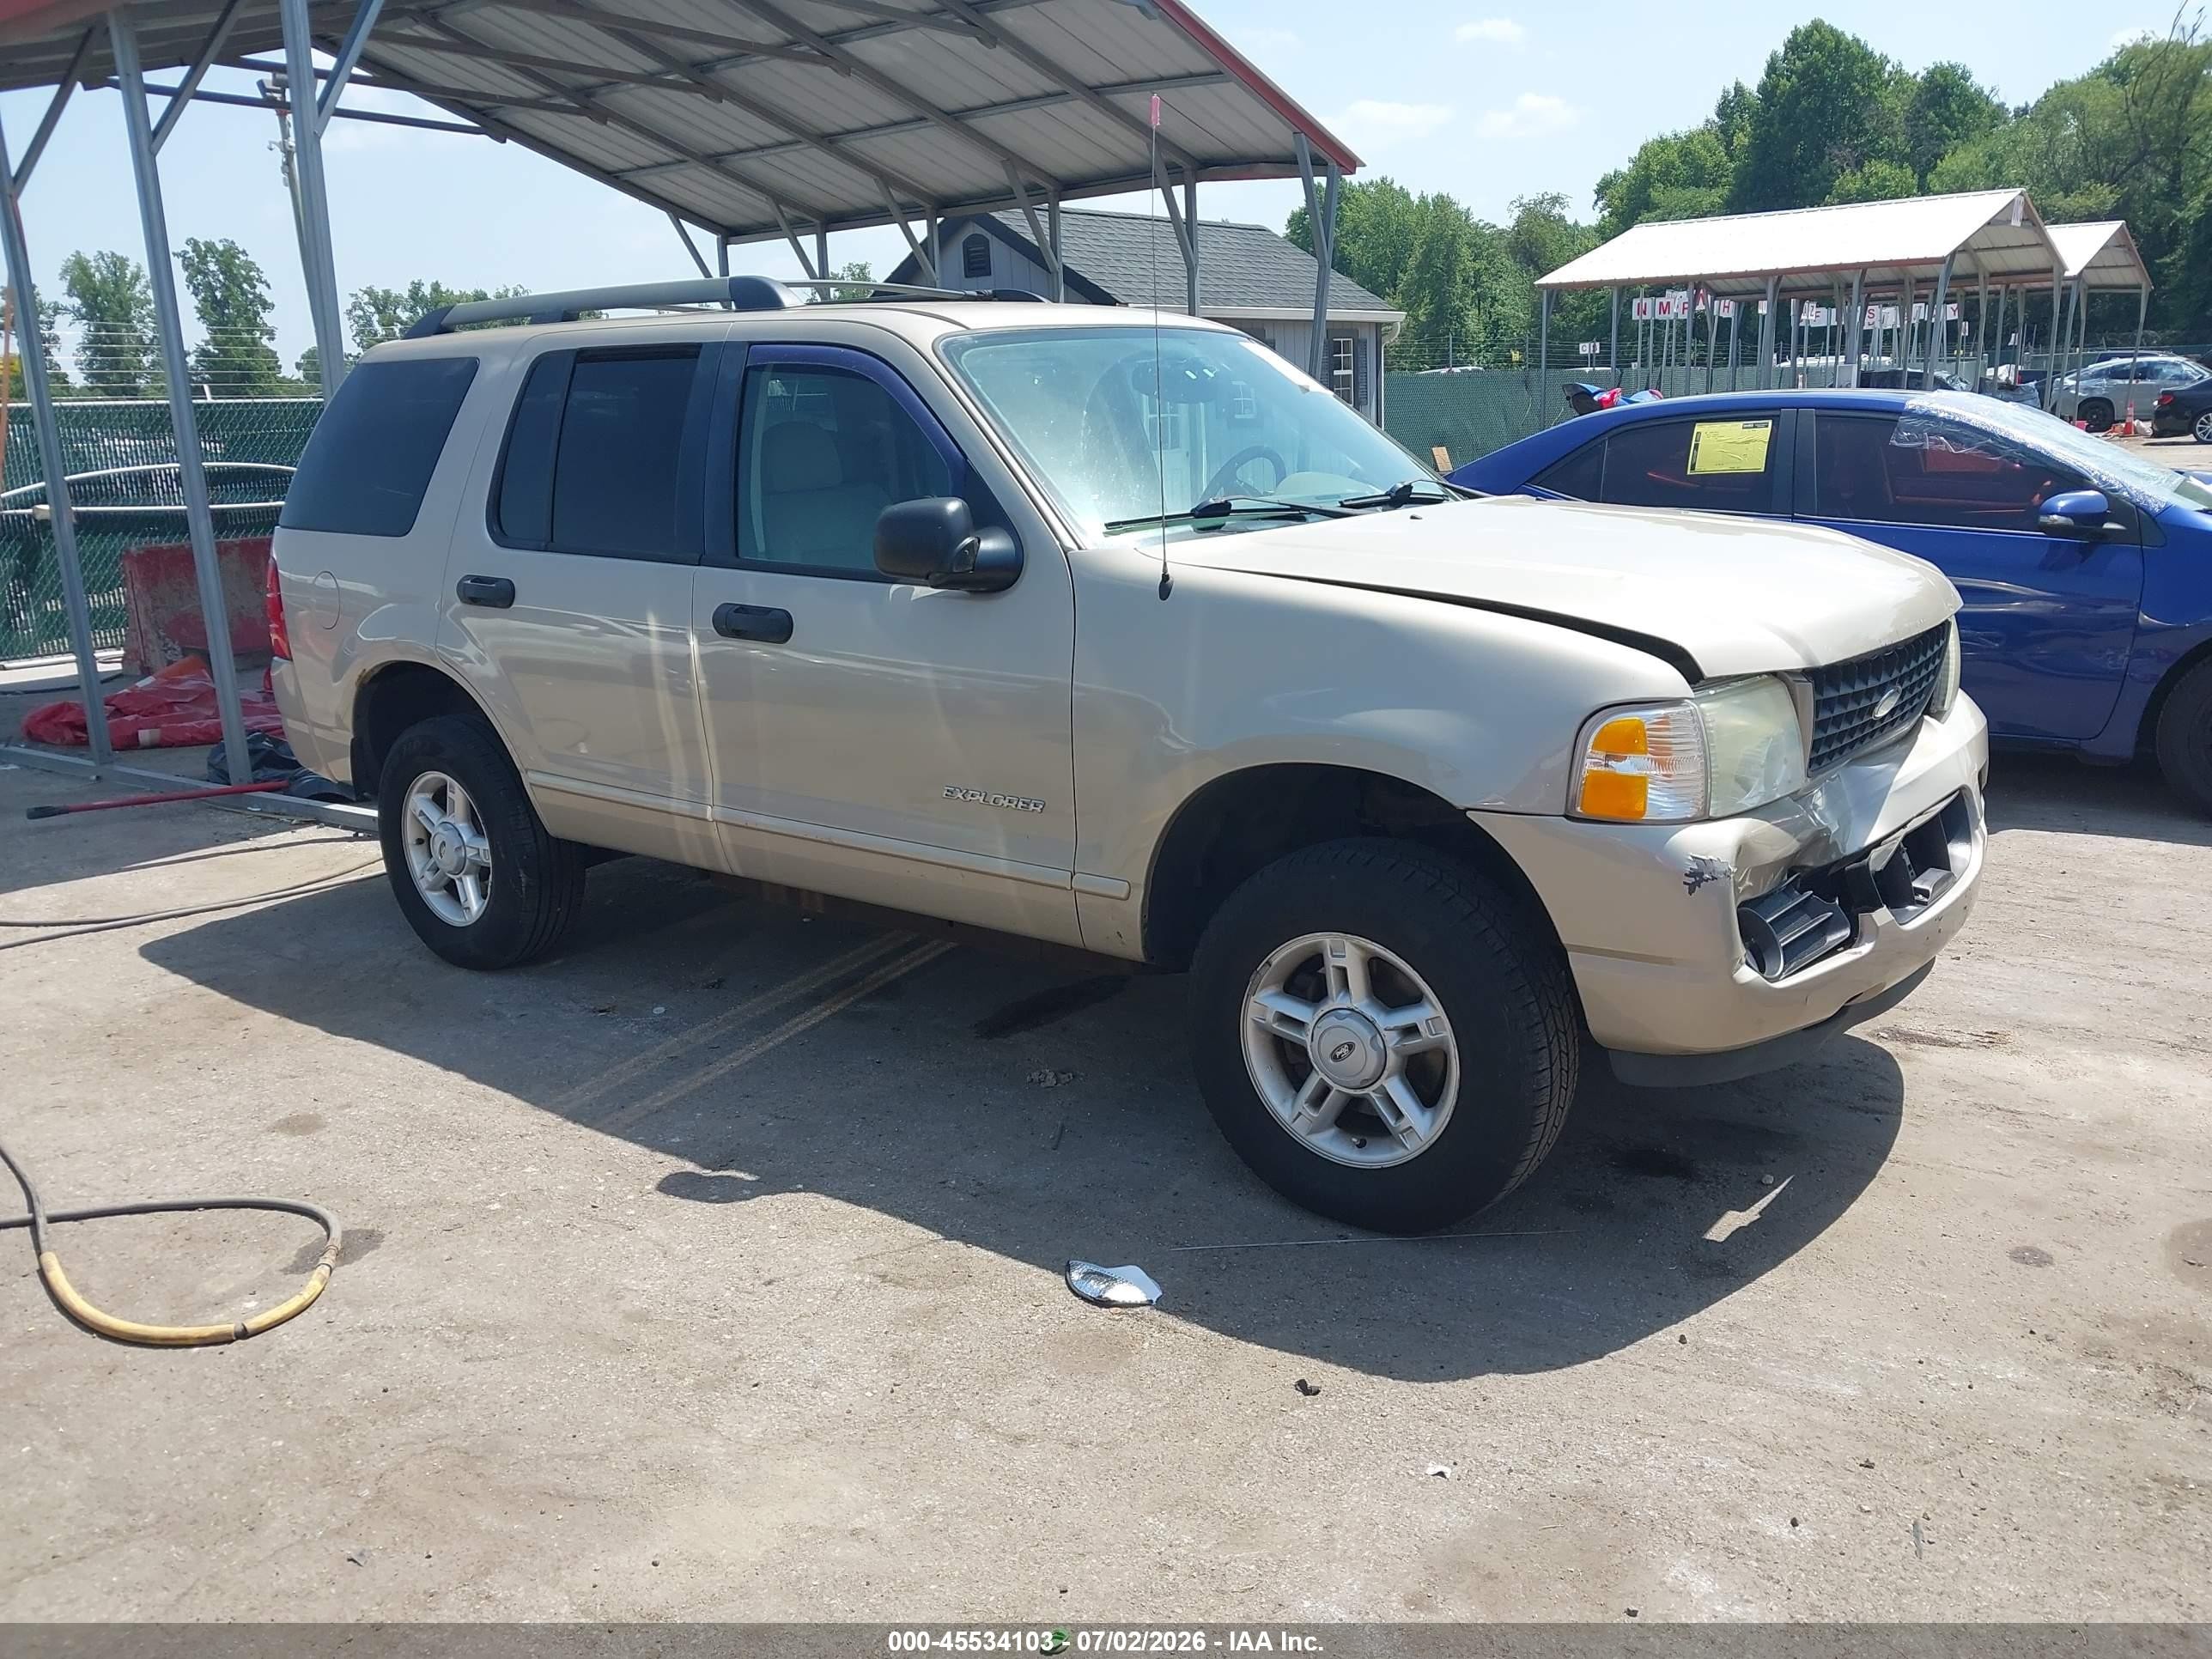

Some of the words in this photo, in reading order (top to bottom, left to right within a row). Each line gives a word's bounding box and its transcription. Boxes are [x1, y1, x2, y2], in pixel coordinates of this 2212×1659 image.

[1658, 301, 1671, 315] M
[1723, 300, 1730, 313] H
[1950, 306, 1959, 317] Y
[1867, 308, 1875, 319] S
[942, 786, 1046, 813] EXPLORER
